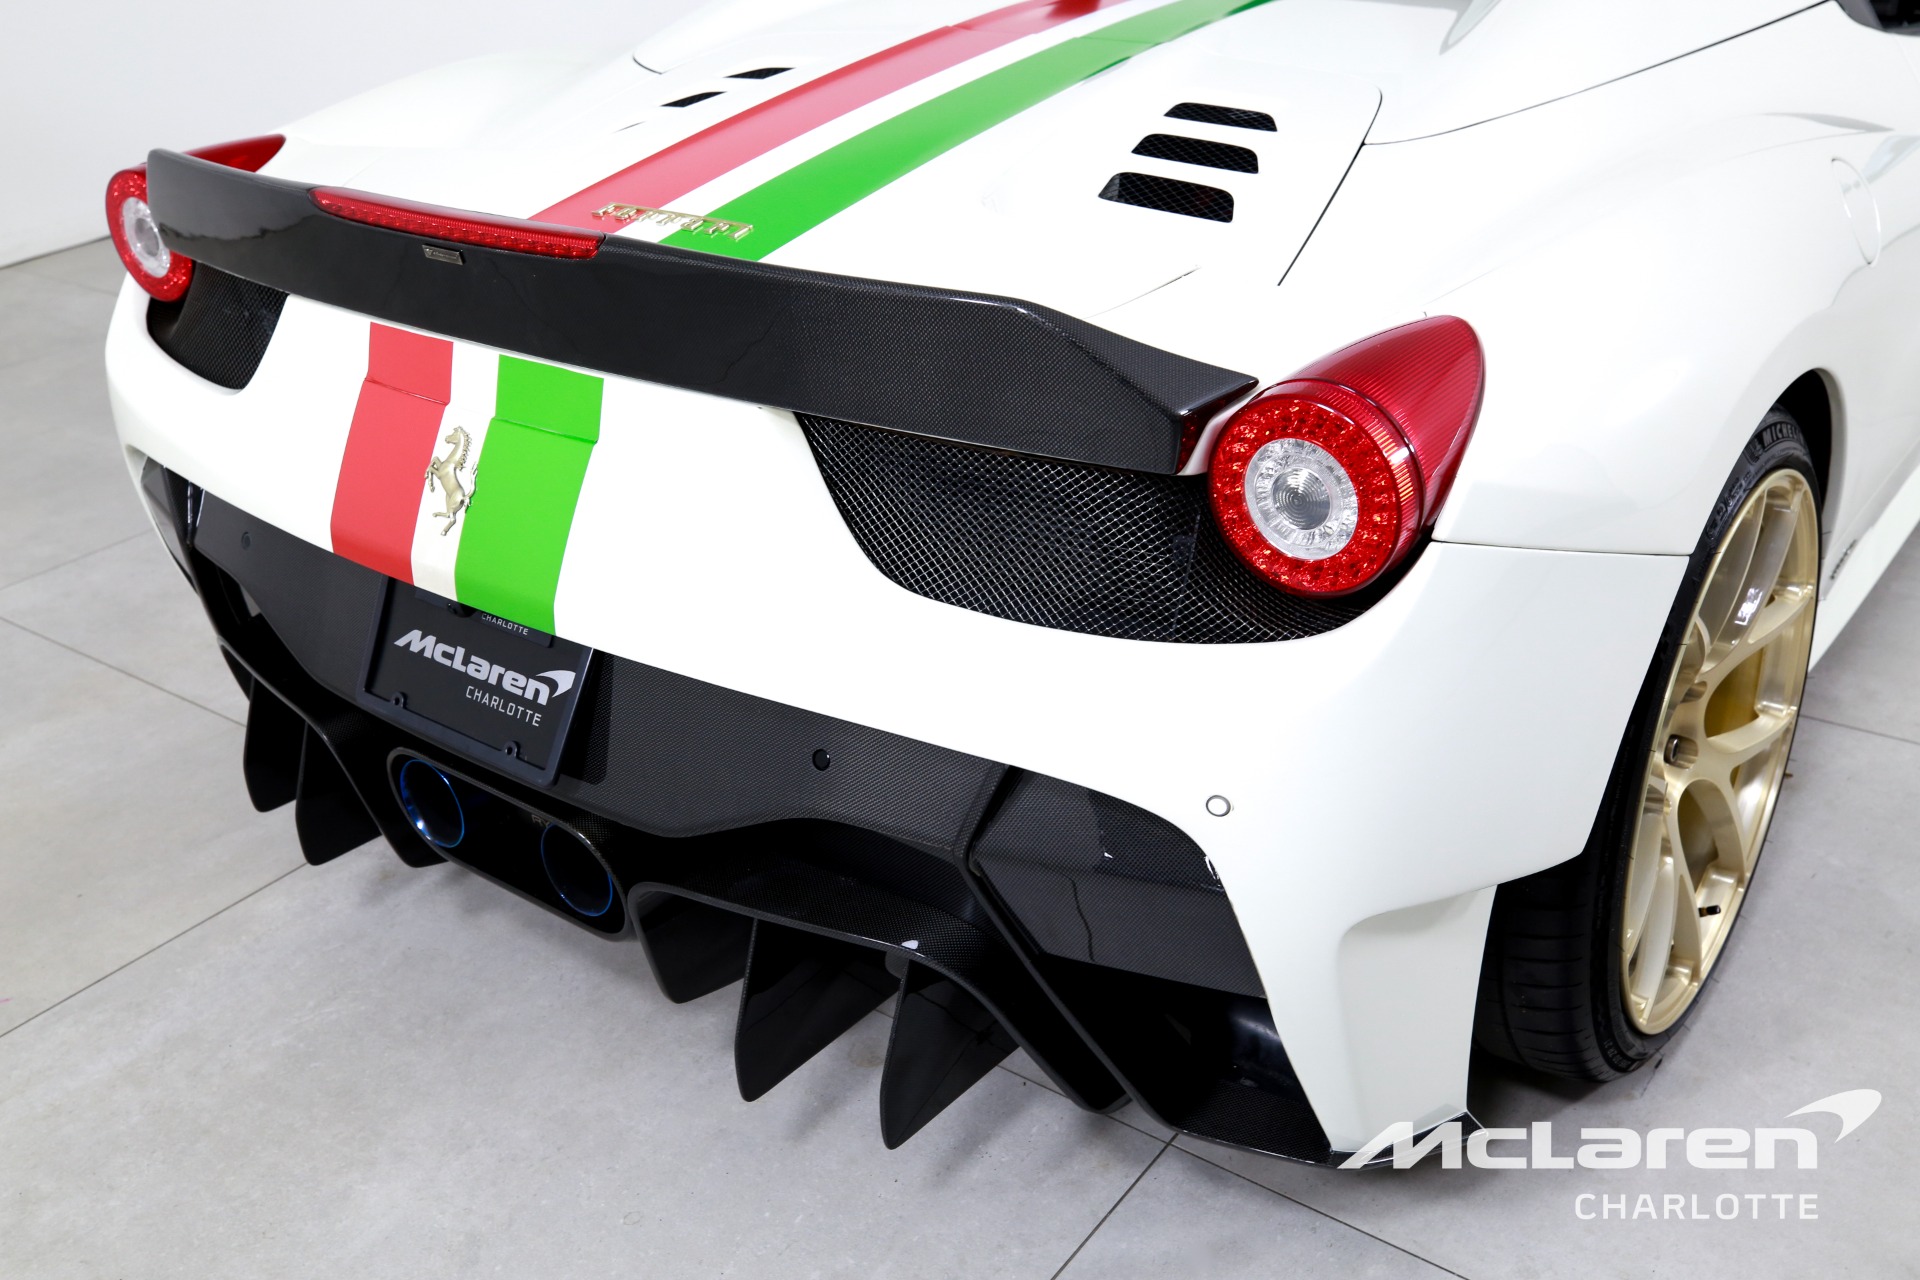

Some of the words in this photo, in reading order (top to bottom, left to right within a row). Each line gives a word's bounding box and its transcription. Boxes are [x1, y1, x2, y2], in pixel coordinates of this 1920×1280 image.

[481, 613, 530, 636] CHARLOTTE
[393, 629, 551, 706] McLaren
[465, 685, 542, 727] CHARLOTTE
